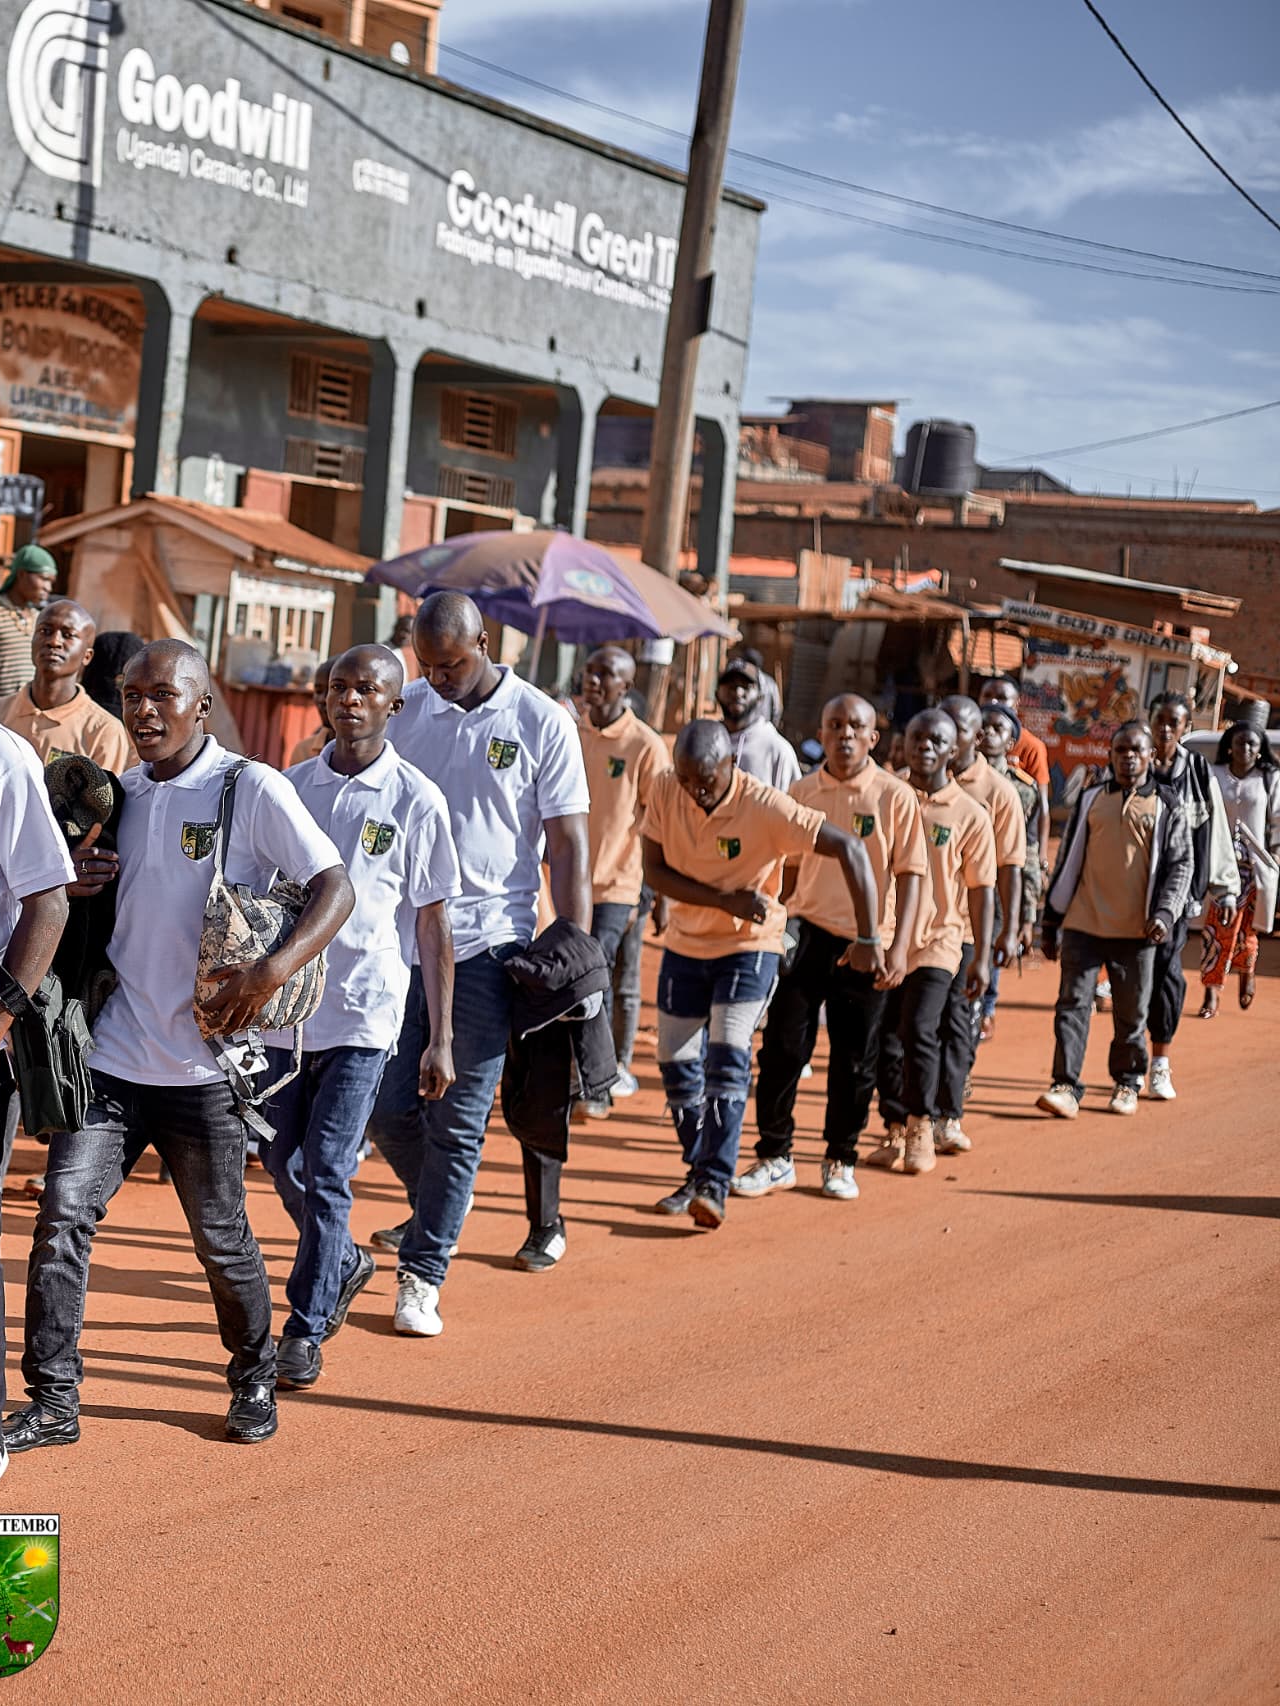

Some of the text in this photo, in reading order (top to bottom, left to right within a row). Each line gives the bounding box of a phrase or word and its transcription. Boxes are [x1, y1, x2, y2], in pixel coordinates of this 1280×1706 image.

[117, 47, 313, 171] Goodwill
[116, 128, 189, 178] (Uganda)
[190, 148, 252, 191] Ceramic
[446, 169, 577, 257] Goodwill
[579, 212, 654, 282] Great
[494, 246, 514, 270] en
